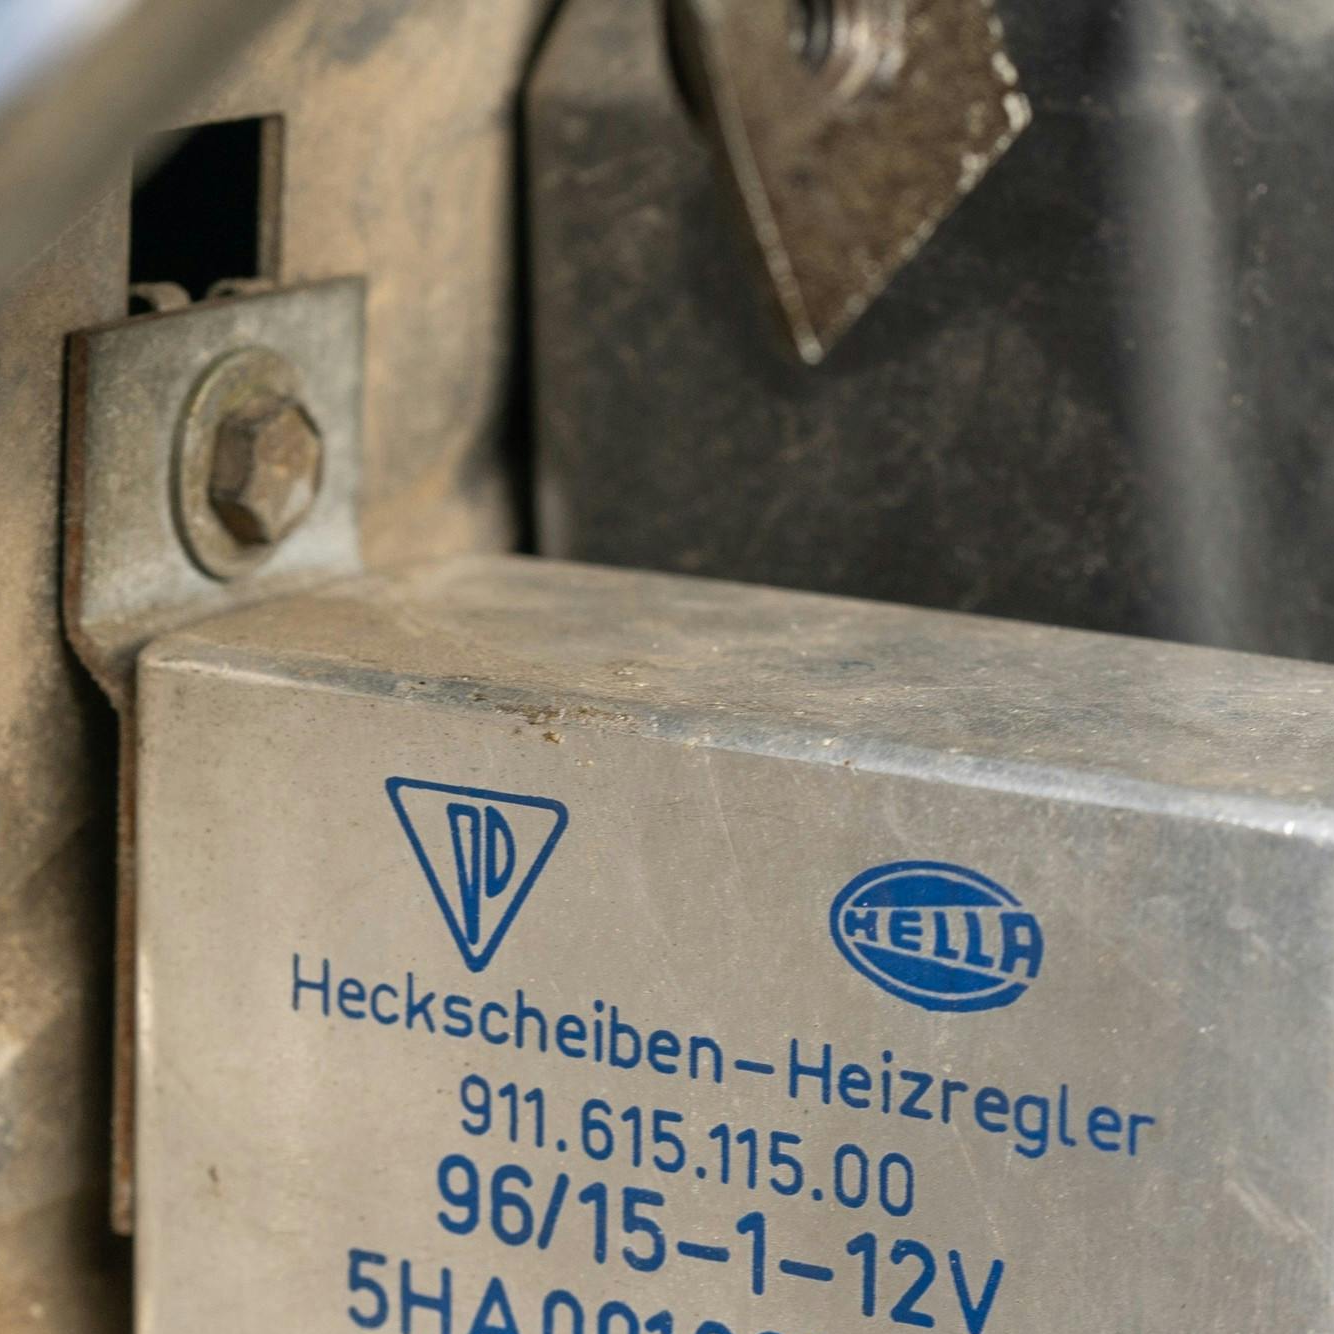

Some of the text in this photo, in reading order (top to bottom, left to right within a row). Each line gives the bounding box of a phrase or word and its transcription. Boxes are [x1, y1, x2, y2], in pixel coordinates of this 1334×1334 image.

[843, 908, 1045, 980] HELLA
[291, 952, 1156, 1160] Heckscheiben-Heizregler
[459, 1073, 915, 1218] 911.615.115.00
